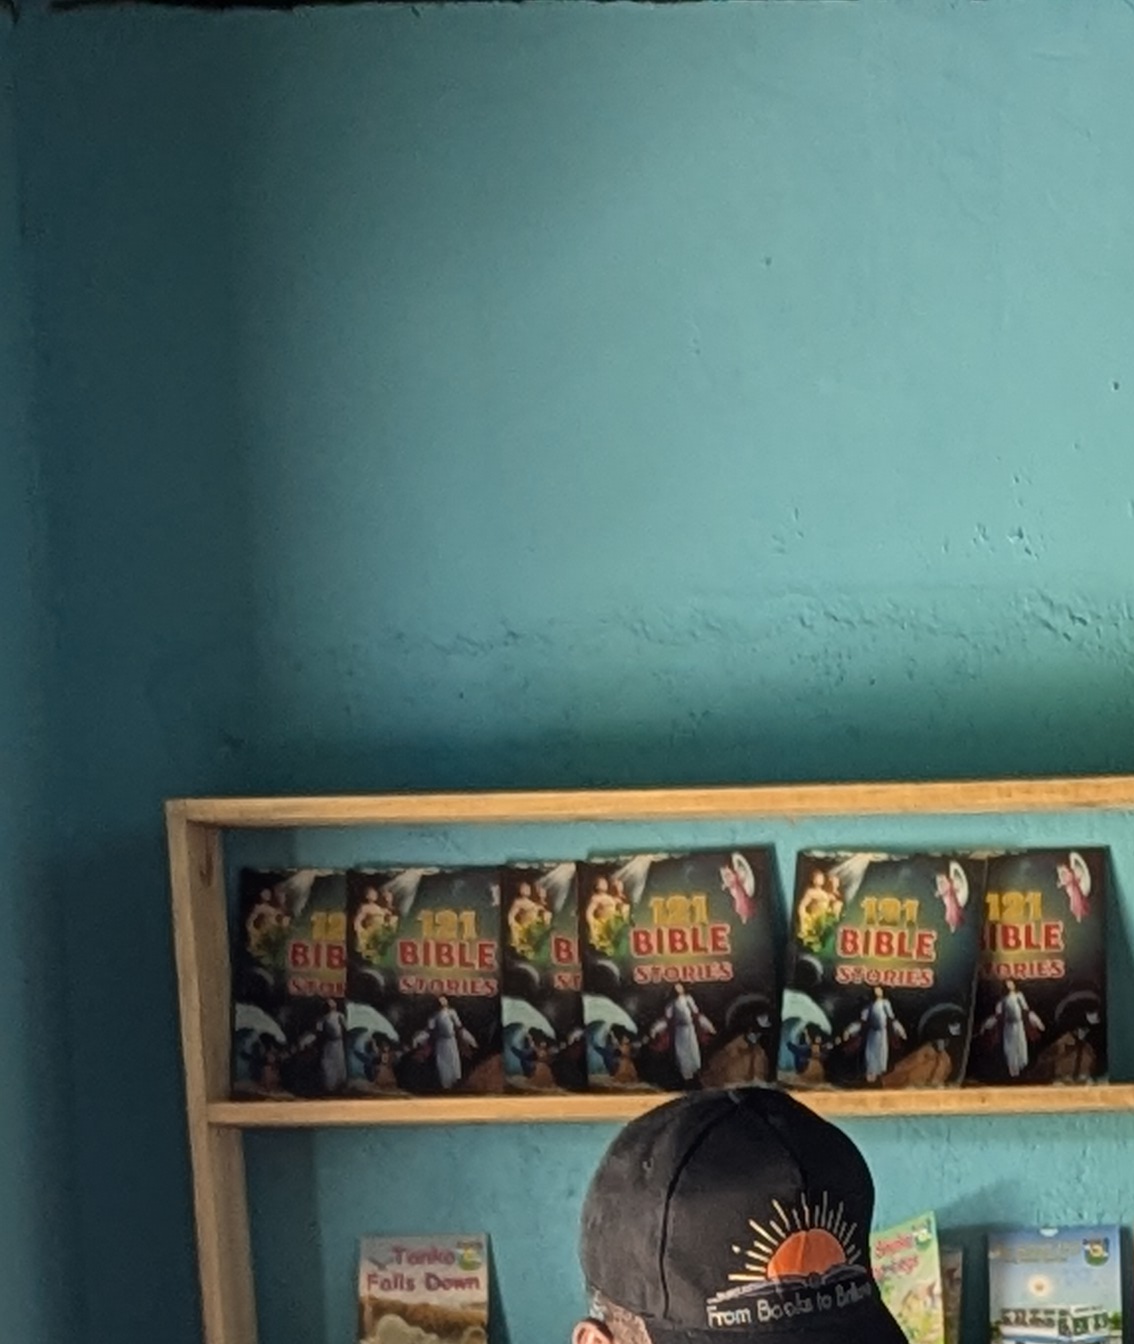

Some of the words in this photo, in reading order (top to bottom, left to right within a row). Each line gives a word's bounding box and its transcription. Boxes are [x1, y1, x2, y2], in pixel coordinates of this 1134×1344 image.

[414, 909, 478, 941] 121
[861, 896, 919, 927] 121
[630, 924, 731, 957] BIBLE
[838, 928, 937, 961] BIBLE
[979, 921, 1063, 953] IBLE
[289, 943, 346, 971] BIB
[398, 940, 497, 971] BIBLE
[981, 957, 1065, 980] TORIES
[398, 974, 498, 998] STORIES
[633, 961, 733, 985] STORIES
[836, 964, 935, 989] STORIES
[365, 1272, 416, 1293] Falls
[424, 1273, 481, 1292] Down
[706, 1304, 752, 1328] From
[756, 1292, 814, 1322] Books
[816, 1291, 832, 1311] to
